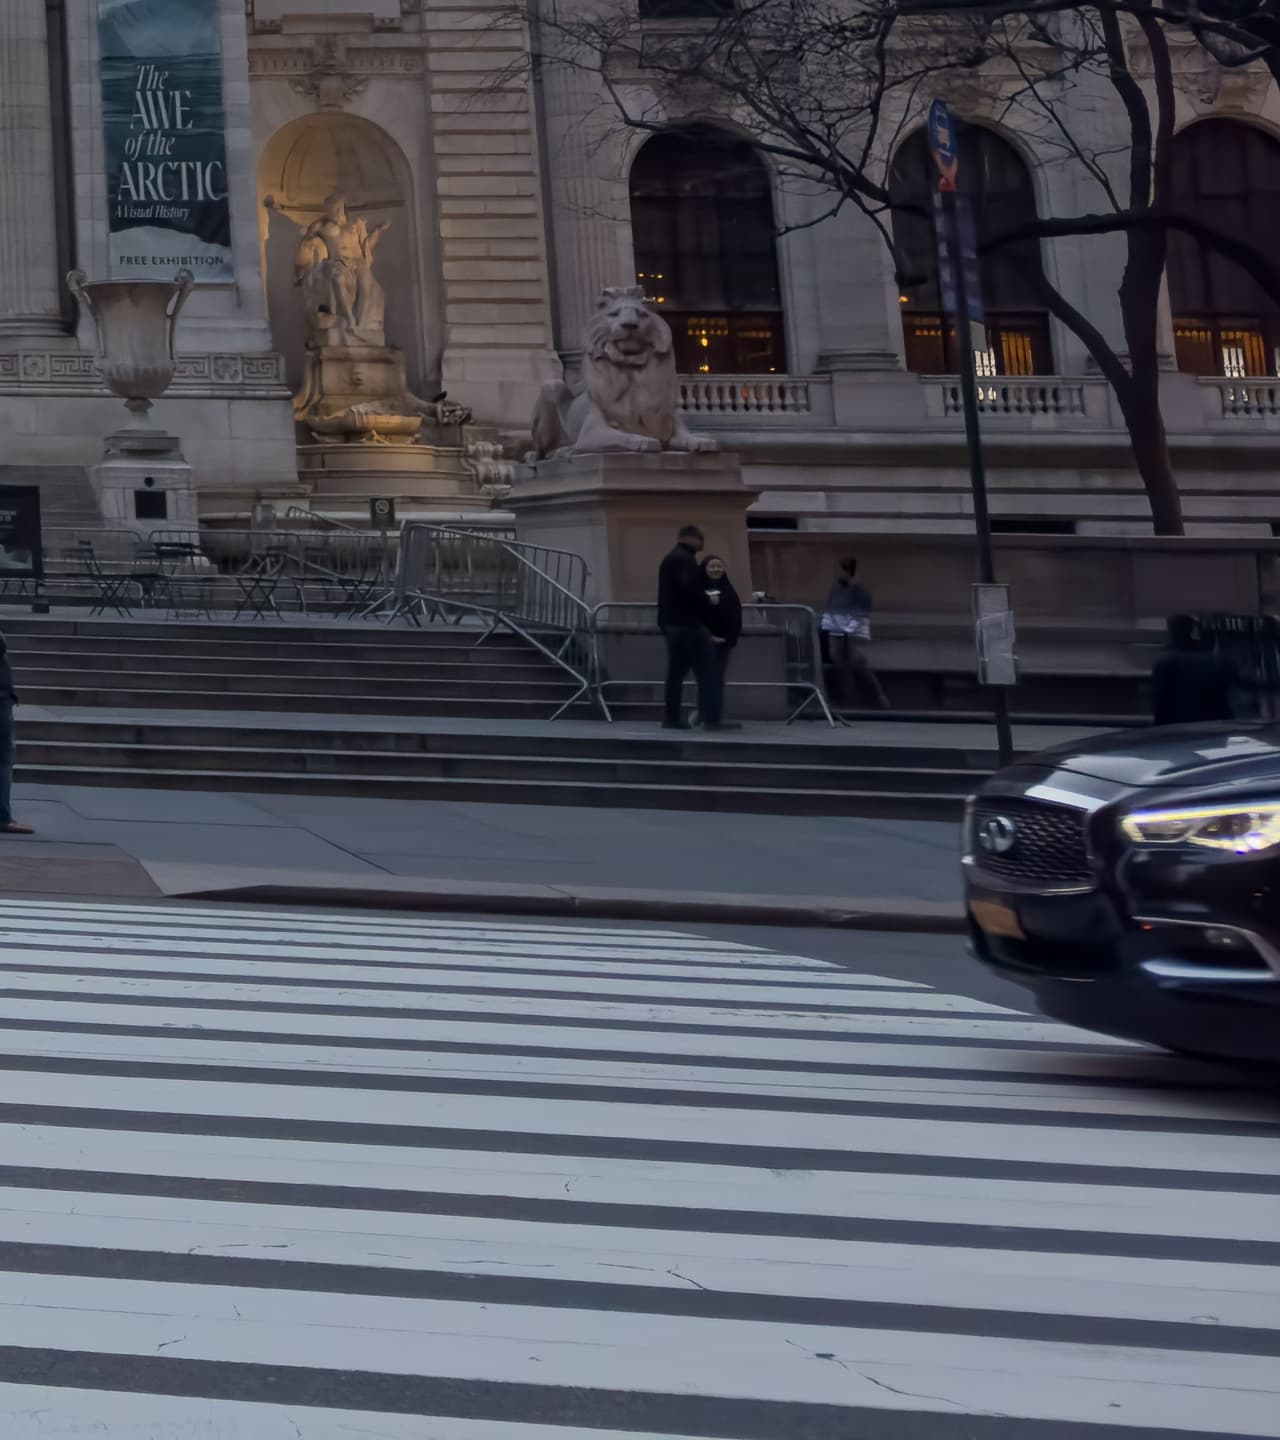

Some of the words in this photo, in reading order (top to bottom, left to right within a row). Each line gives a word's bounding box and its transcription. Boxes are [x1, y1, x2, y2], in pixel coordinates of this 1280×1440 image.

[136, 63, 168, 90] The
[130, 90, 193, 129] AWE
[125, 130, 146, 160] of
[146, 130, 175, 156] the
[117, 161, 225, 201] ARCTIC
[154, 203, 190, 221] History
[119, 255, 148, 266] FREE
[151, 255, 224, 266] EXHIBITION
